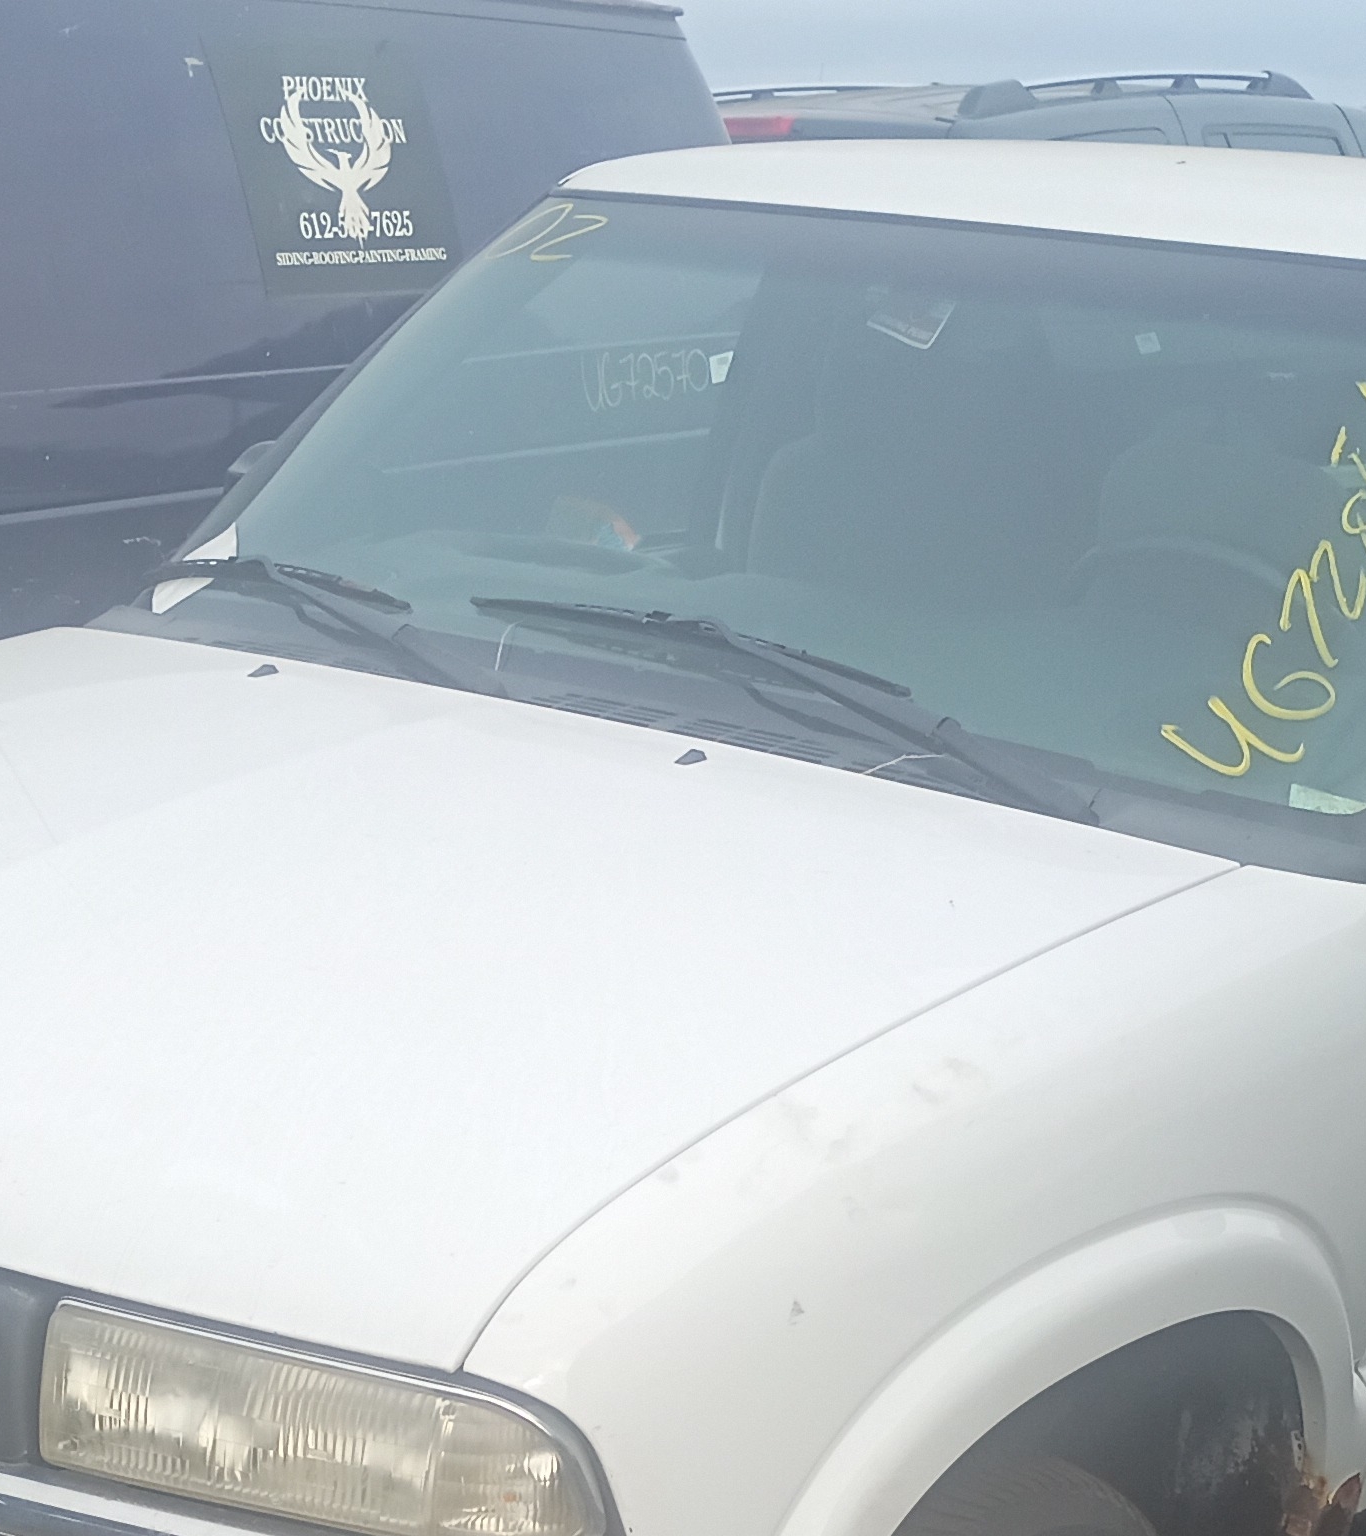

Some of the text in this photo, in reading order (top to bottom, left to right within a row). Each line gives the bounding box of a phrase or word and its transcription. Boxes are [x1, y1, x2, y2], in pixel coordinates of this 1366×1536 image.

[282, 76, 368, 102] PHOENIX
[260, 117, 407, 144] COSTRUCON
[299, 211, 413, 240] 612-5-7625
